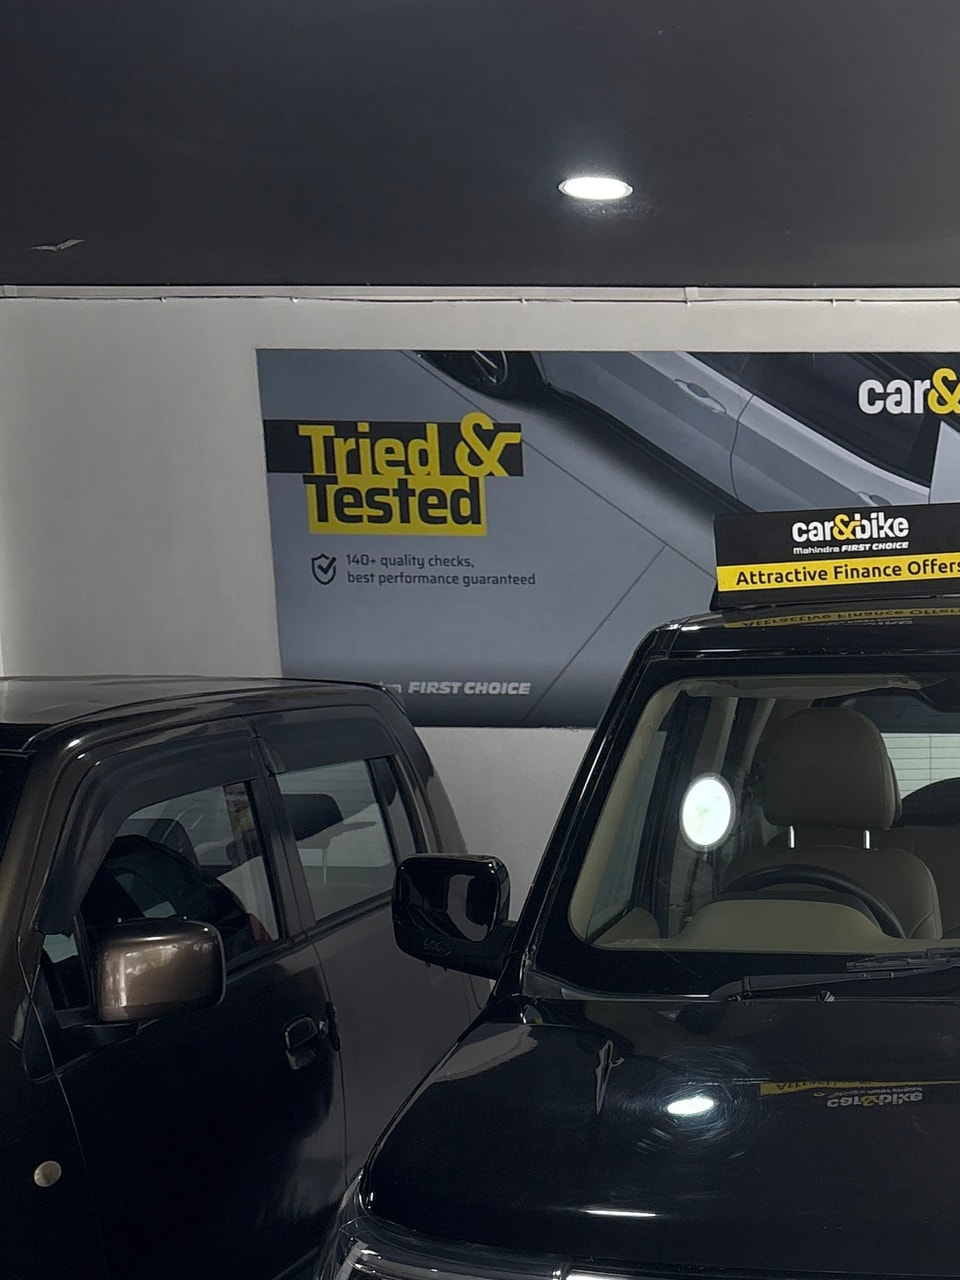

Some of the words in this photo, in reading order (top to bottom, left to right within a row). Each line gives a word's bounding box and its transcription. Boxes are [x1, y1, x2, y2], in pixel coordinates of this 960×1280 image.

[298, 422, 440, 476] Tried
[455, 412, 521, 476] &
[303, 475, 481, 524] Tested
[792, 512, 909, 542] car&bike
[793, 546, 840, 555] Mahindra
[841, 543, 871, 552] FIRST
[872, 541, 909, 550] CHOICE
[346, 554, 376, 566] 140+
[380, 554, 425, 569] quality
[428, 555, 474, 568] checks,
[347, 572, 375, 583] best
[379, 572, 459, 586] performance
[463, 574, 536, 587] guaranteed
[736, 565, 828, 586] Attractive
[834, 562, 902, 581] Finance
[408, 681, 462, 694] FIRST
[464, 682, 531, 695] CHOICE
